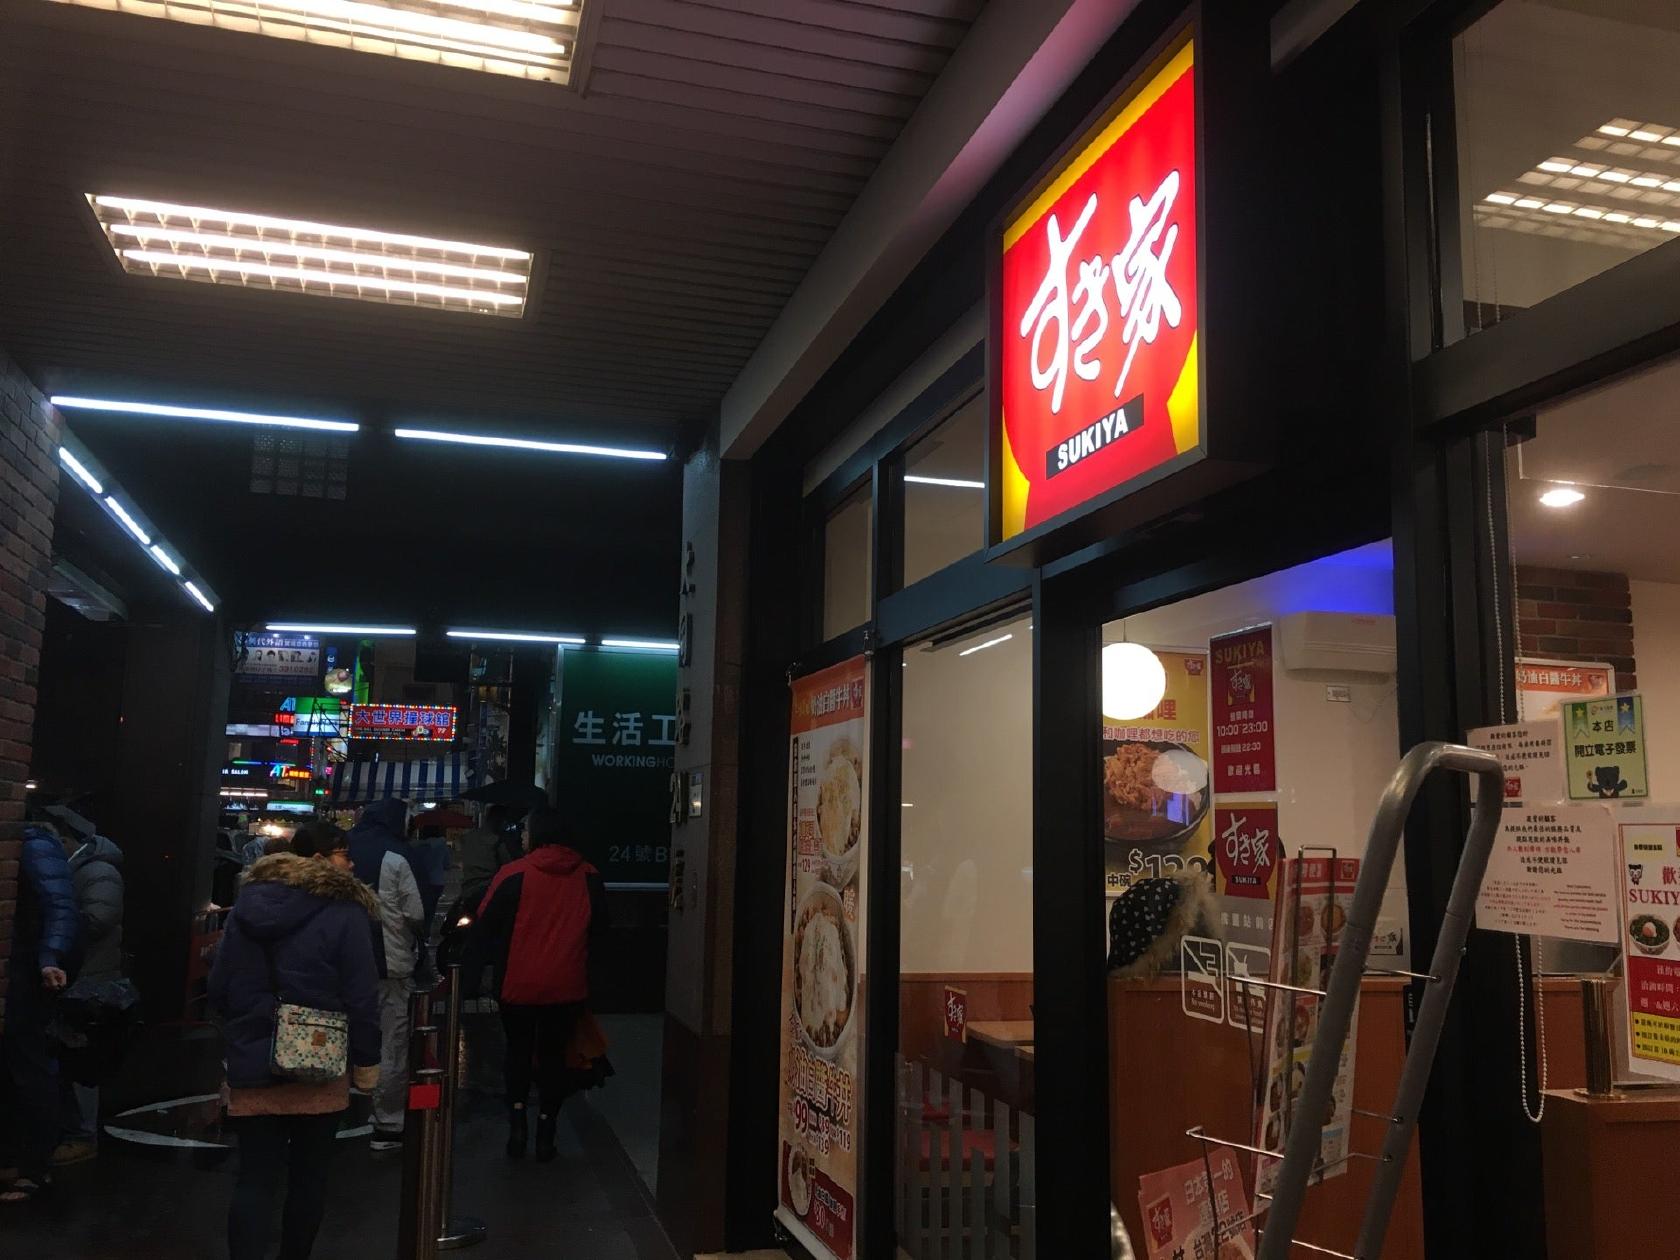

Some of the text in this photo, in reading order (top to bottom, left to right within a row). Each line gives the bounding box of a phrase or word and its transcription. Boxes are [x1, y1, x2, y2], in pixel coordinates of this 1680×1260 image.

[1019, 168, 1182, 415] すき家
[1057, 408, 1129, 470] SUKIYA
[1215, 641, 1264, 664] SUKIYA
[1230, 669, 1252, 691] すき家
[355, 709, 451, 727] 大世界撞球館
[572, 710, 676, 746] 生活工
[1592, 720, 1614, 732] 本店
[1574, 741, 1636, 757] 開立電子發票
[1222, 812, 1271, 874] すき家
[1663, 866, 1680, 884] 歡
[795, 1098, 809, 1134] 99
